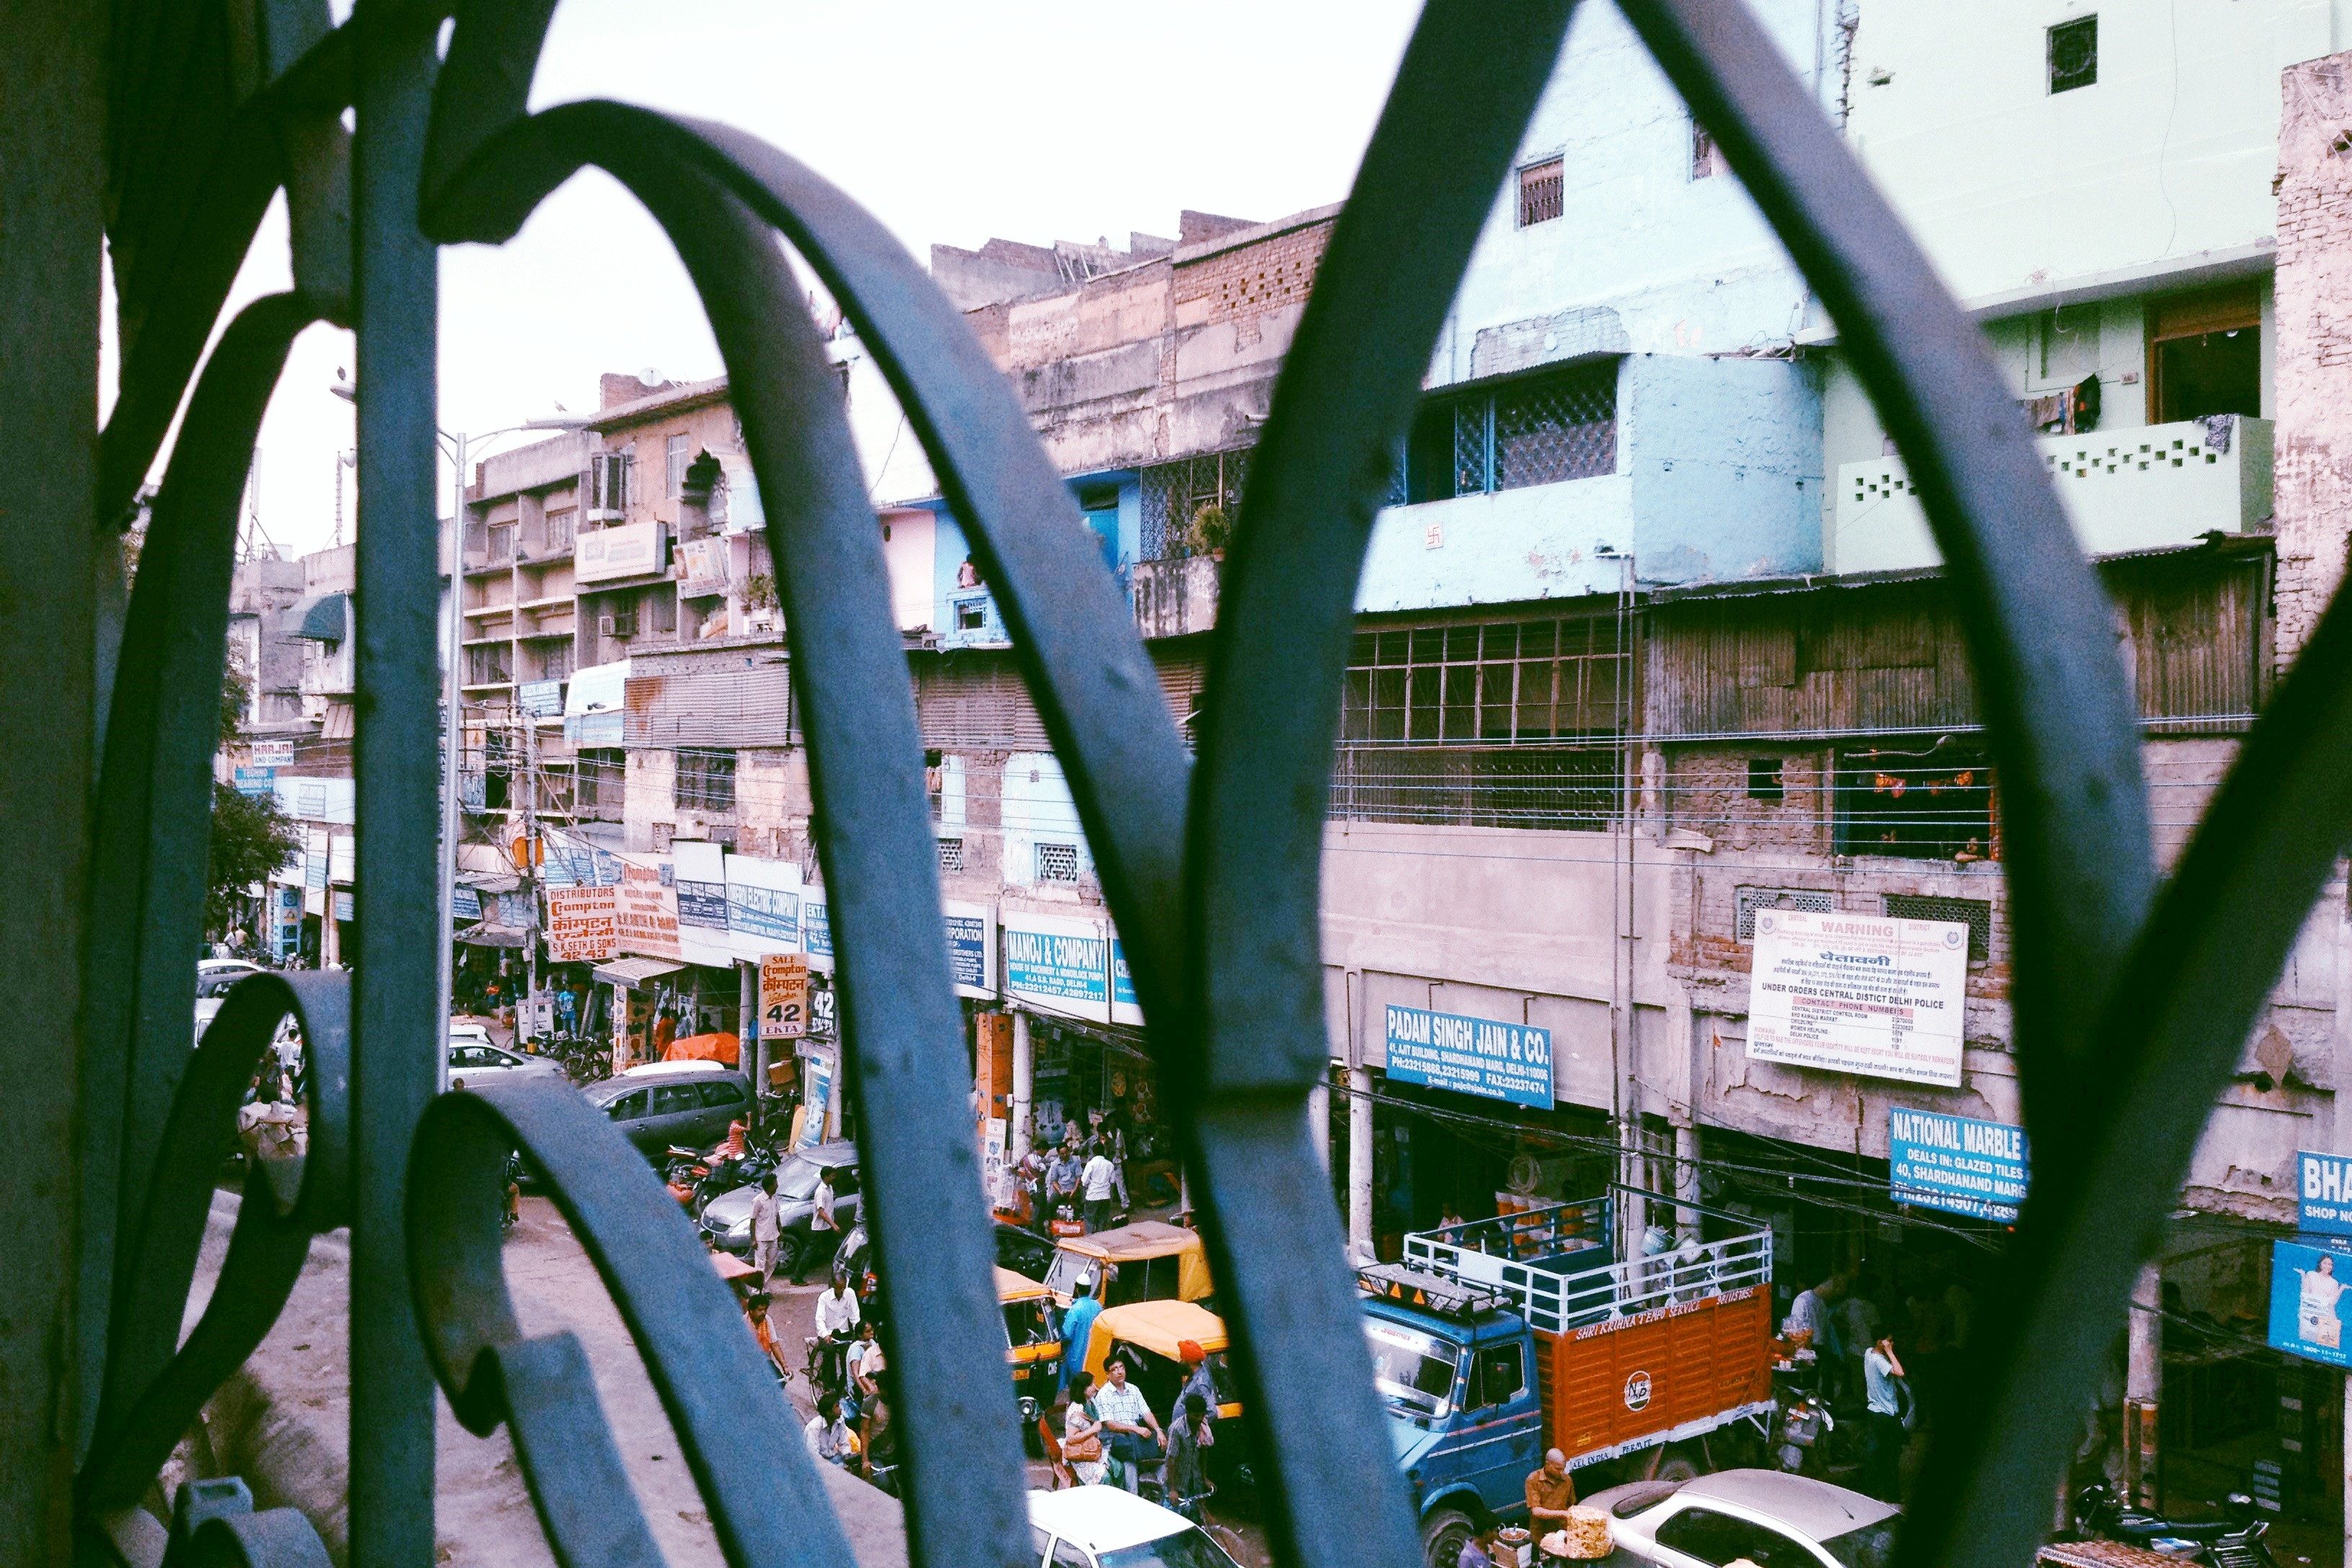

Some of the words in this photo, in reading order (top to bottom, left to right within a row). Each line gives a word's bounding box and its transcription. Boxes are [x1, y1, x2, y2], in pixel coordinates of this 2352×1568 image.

[551, 887, 614, 899] DISTRIBUTORS
[551, 898, 615, 916] Crompton
[806, 904, 827, 919] EKTA
[1821, 921, 1893, 937] WARNING
[597, 938, 615, 948] SONS
[1008, 932, 1041, 963] MANOJ
[1044, 936, 1052, 964] &
[1054, 937, 1103, 971] COMPANY
[560, 949, 606, 960] 42-43
[1819, 950, 1892, 966] चेतावनी
[763, 964, 806, 976] Crompton
[1024, 963, 1029, 972] OF
[1115, 959, 1130, 978] CH
[1762, 982, 1786, 992] UNDER
[1788, 985, 1817, 995] ORDERS
[1819, 989, 1853, 999] CENTRAL
[1856, 992, 1886, 1002] DISTICT
[1889, 996, 1912, 1005] DELHI
[1915, 999, 1943, 1009] POLICE
[1801, 997, 1834, 1007] CONTACT
[1839, 1002, 1863, 1010] PHONE
[767, 1004, 800, 1023] 42
[814, 992, 834, 1018] 42
[767, 1025, 798, 1034] EKTA
[1388, 1009, 1430, 1044] PADAM
[1433, 1015, 1472, 1051] SINGH
[1476, 1023, 1507, 1057] JAIN
[1510, 1029, 1521, 1060] &
[1524, 1030, 1548, 1065] CO.
[1893, 1112, 1961, 1150] NATIONAL
[1964, 1123, 2022, 1160] MARBLE
[1907, 1148, 1937, 1164] DEALS
[1940, 1154, 1951, 1167] IN:
[1954, 1156, 1992, 1174] GLAZED
[1994, 1163, 2023, 1180] TILES
[1896, 1162, 1910, 1179] 40,
[1913, 1165, 1991, 1193] SHARDHANAND
[2305, 1206, 2337, 1220] SHOP
[1576, 1325, 1598, 1340] SHRI
[1669, 1301, 1701, 1317] SERVICE
[1048, 1361, 1058, 1376] CNG
[1588, 1453, 1608, 1464] INDIA
[1622, 1439, 1652, 1453] PERMIT
